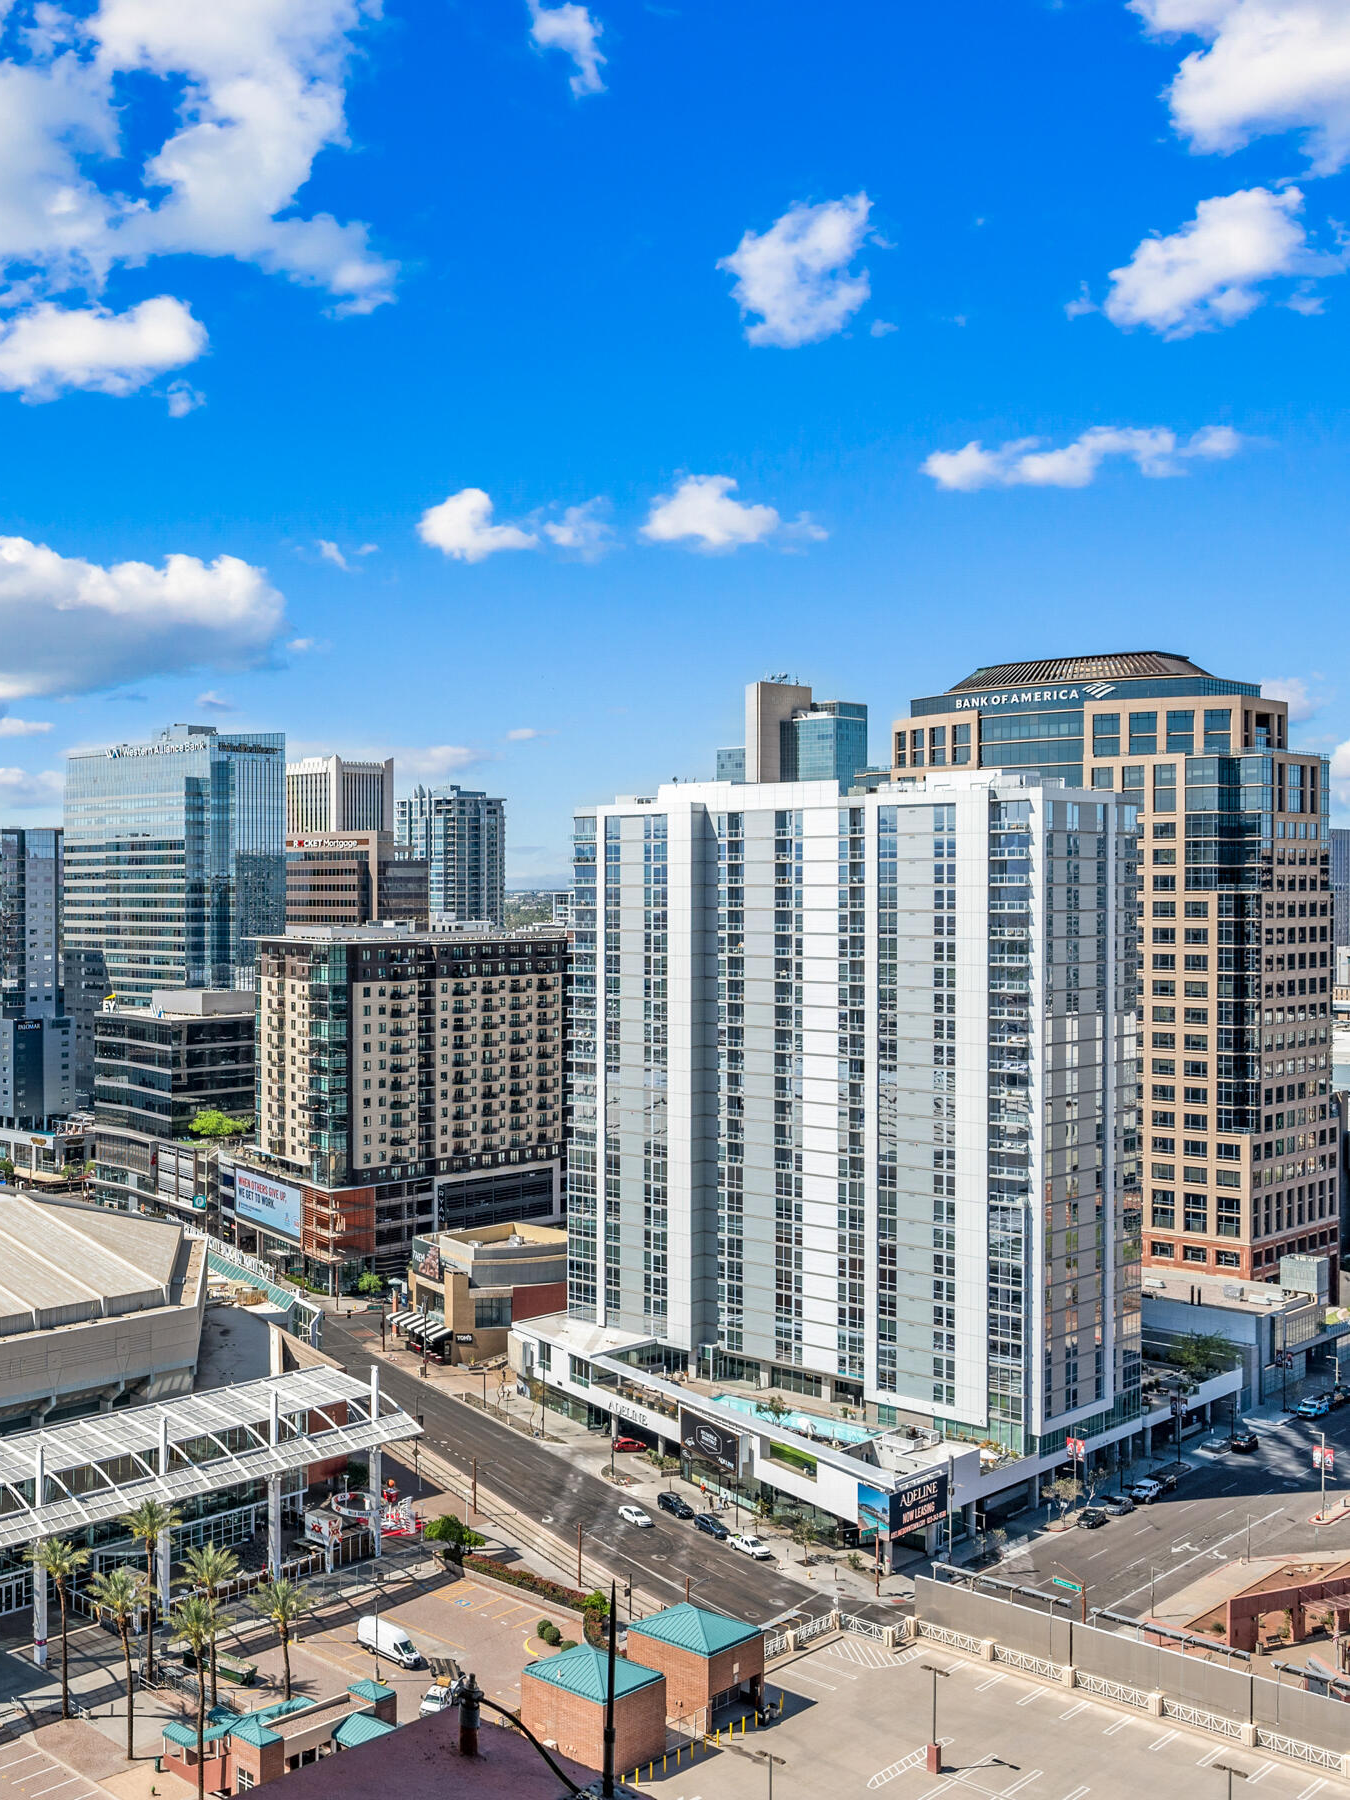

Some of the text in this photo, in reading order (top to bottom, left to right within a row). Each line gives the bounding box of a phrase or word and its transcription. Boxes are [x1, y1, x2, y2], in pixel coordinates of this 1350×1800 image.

[955, 689, 1079, 709] BANK OF AMERICA
[123, 747, 153, 758] Western
[154, 744, 184, 755] Alliance
[184, 740, 204, 752] Bank
[323, 840, 358, 849] Mortgage
[103, 1000, 116, 1013] EY
[238, 1186, 245, 1196] WE
[245, 1190, 254, 1201] GET
[255, 1193, 261, 1204] TO
[250, 1180, 268, 1196] OTHERS
[269, 1187, 279, 1200] GIVE
[608, 1400, 648, 1426] ADELINE
[899, 1481, 938, 1507] ADELINE
[902, 1509, 914, 1525] NOW
[914, 1501, 935, 1519] LEASING
